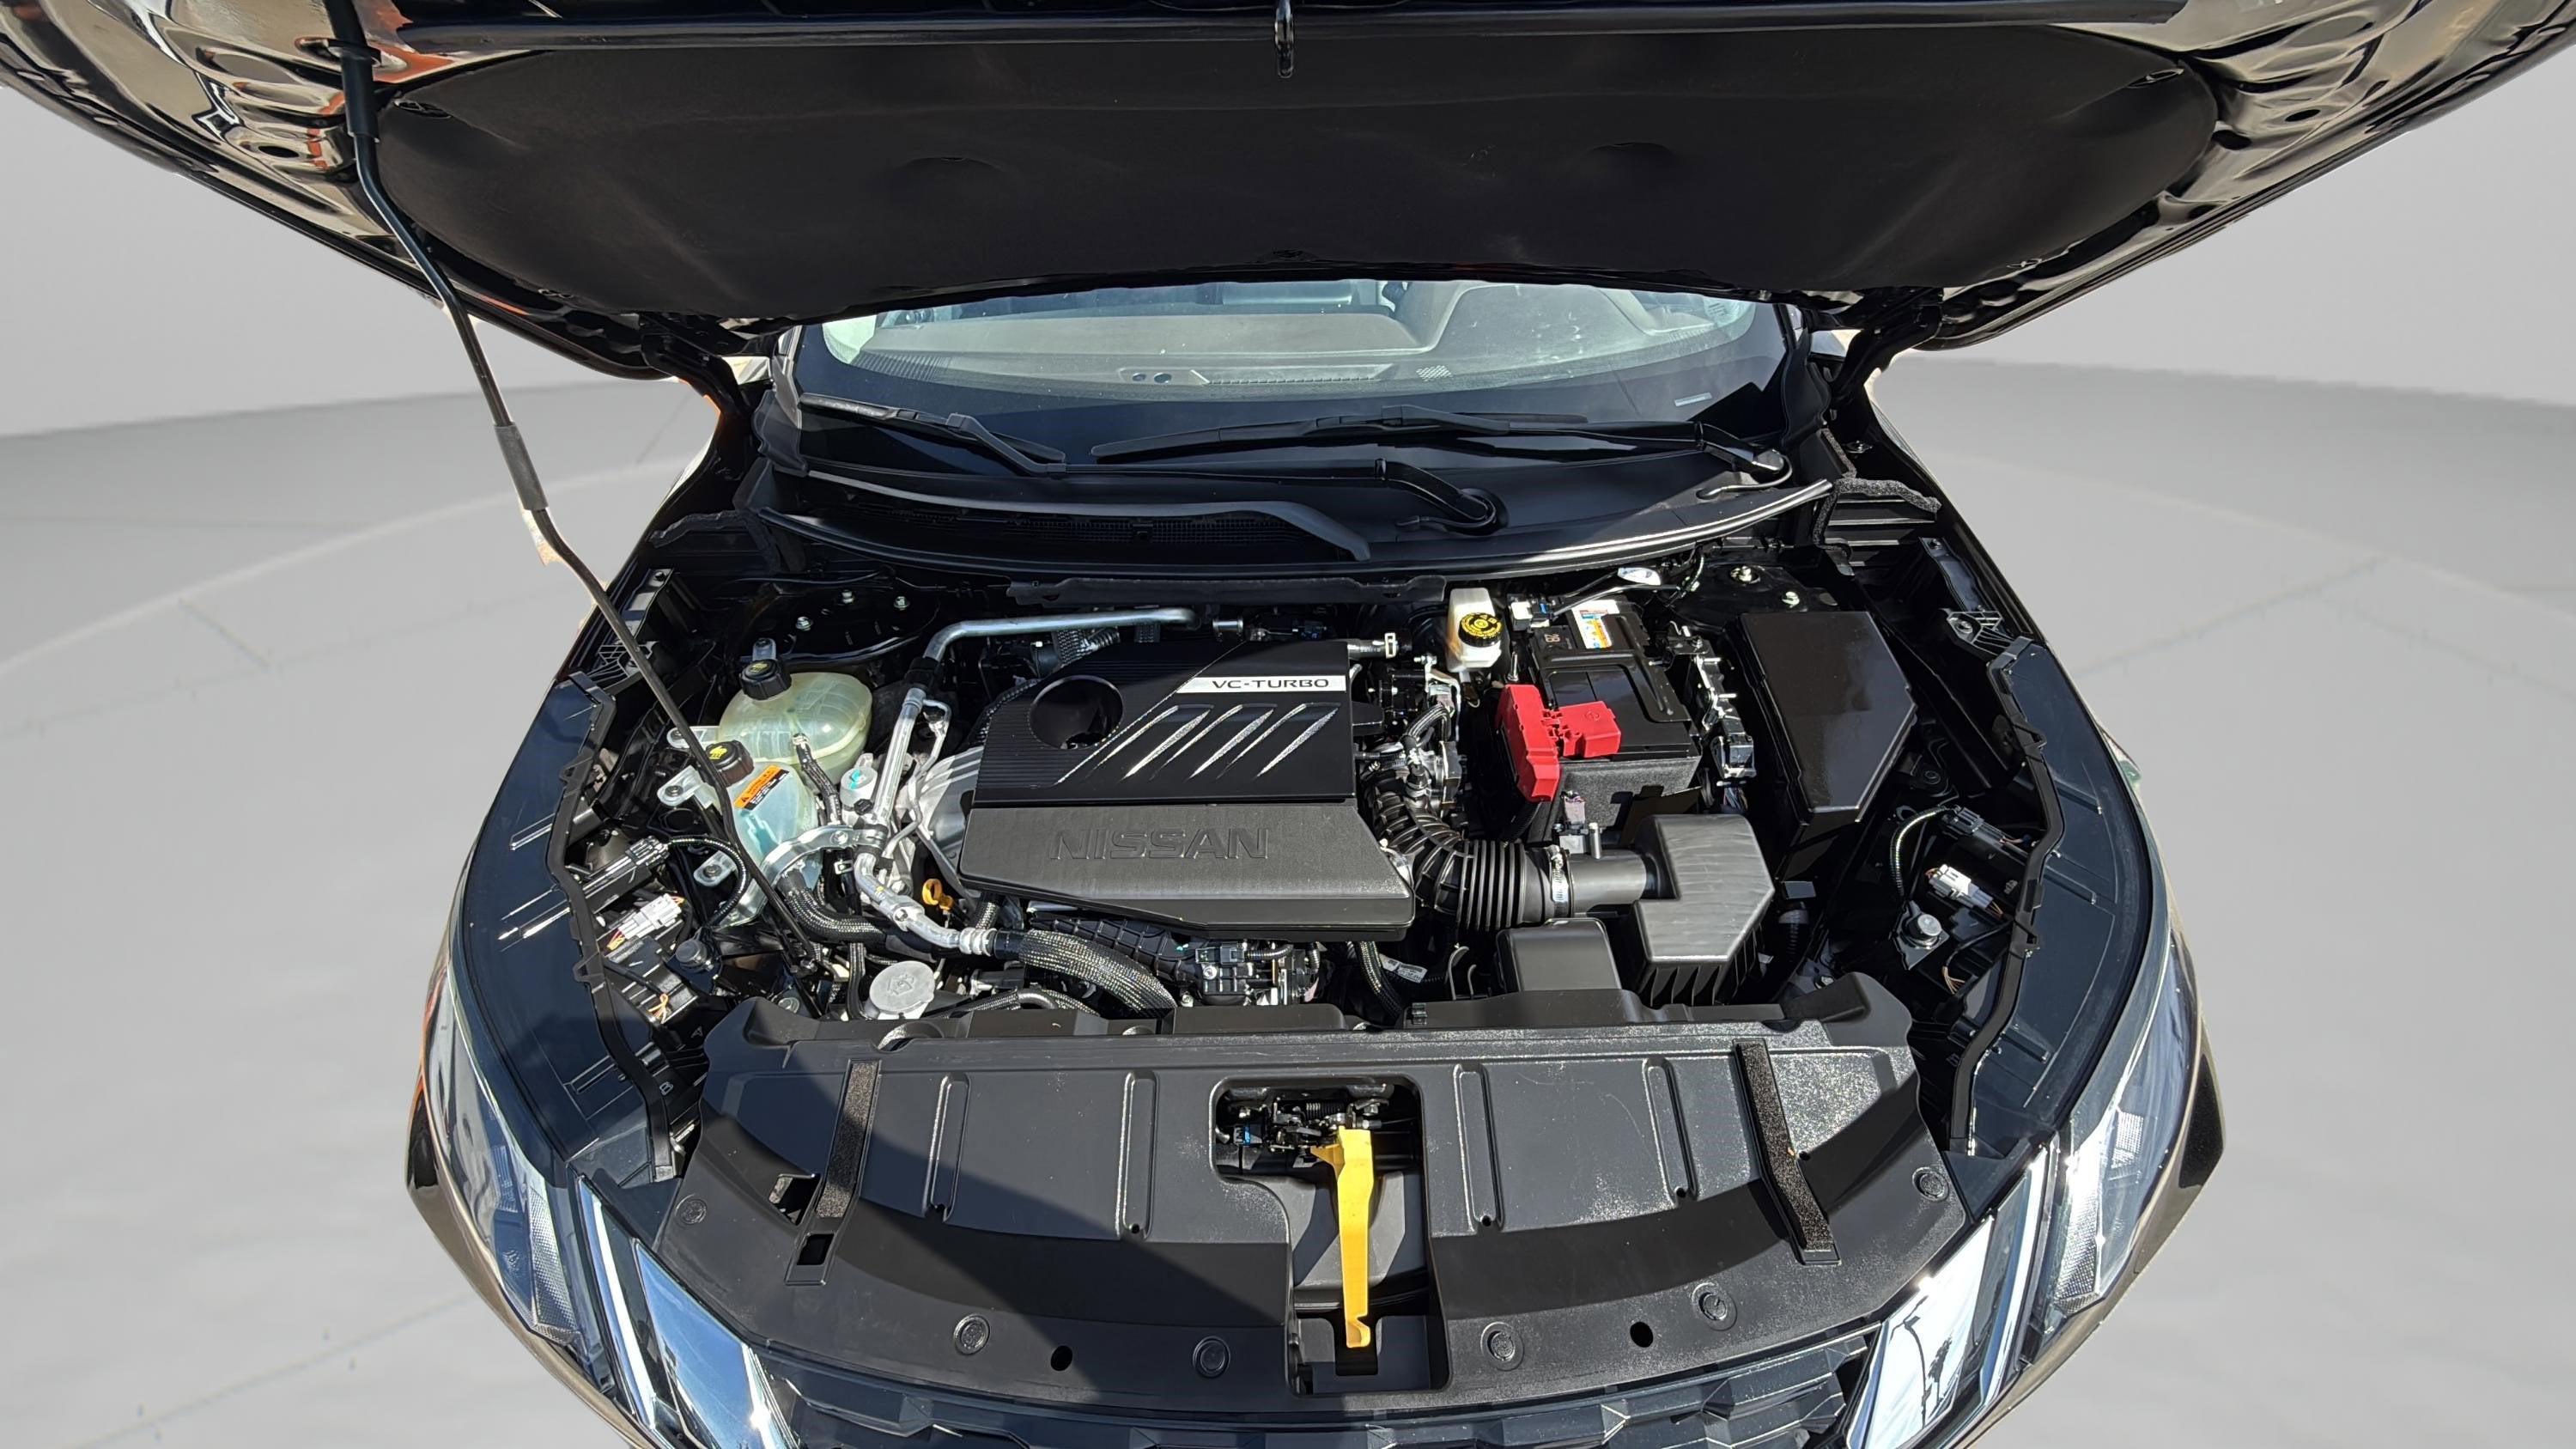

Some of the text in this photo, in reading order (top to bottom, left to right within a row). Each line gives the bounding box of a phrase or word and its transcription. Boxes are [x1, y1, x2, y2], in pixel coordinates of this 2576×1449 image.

[1212, 679, 1329, 689] VC-TURBO
[1050, 828, 1269, 860] NISSAN
[659, 1081, 673, 1095] B
